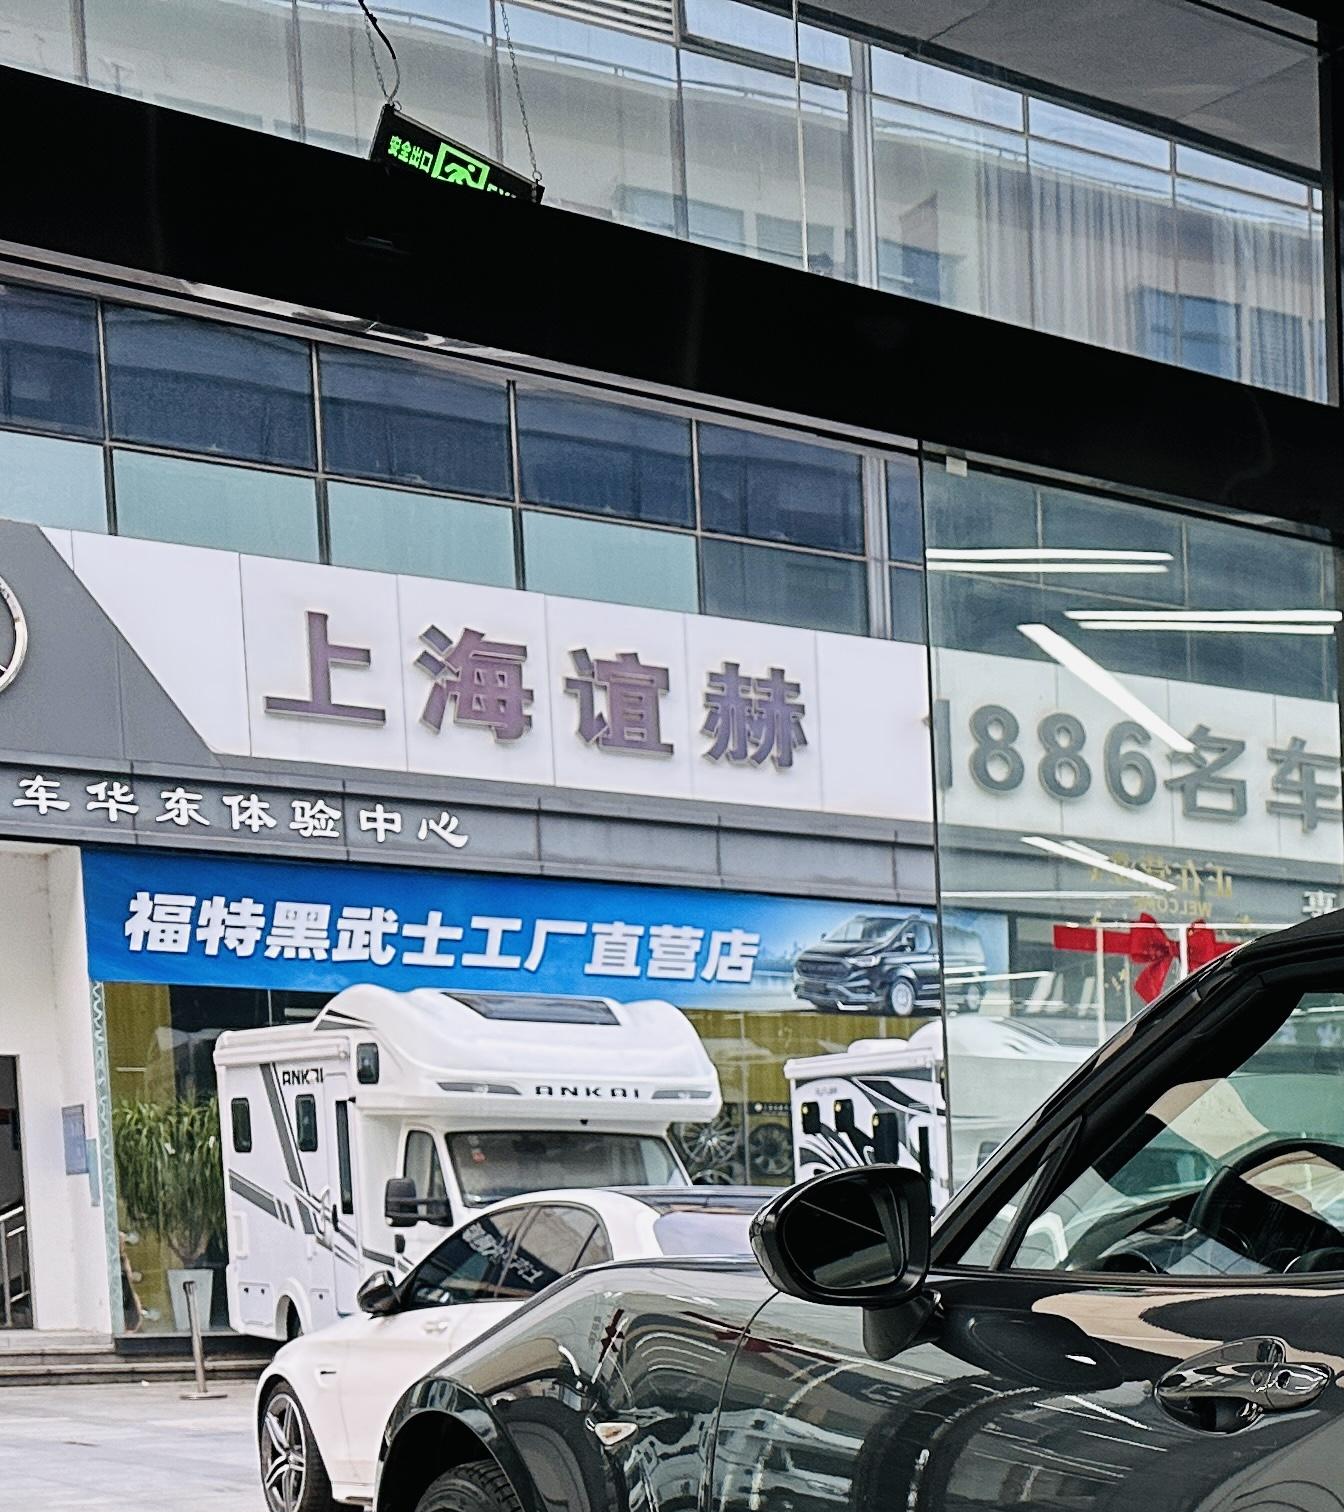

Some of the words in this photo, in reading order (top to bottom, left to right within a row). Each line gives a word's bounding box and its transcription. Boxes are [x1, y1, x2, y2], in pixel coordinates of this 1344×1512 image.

[388, 136, 434, 174] 安全出口
[264, 611, 807, 770] 上海谊赫
[12, 775, 469, 849] 车华东体验中心
[125, 891, 761, 983] 福特黑武士工厂直营店
[535, 1085, 639, 1099] ANKAI
